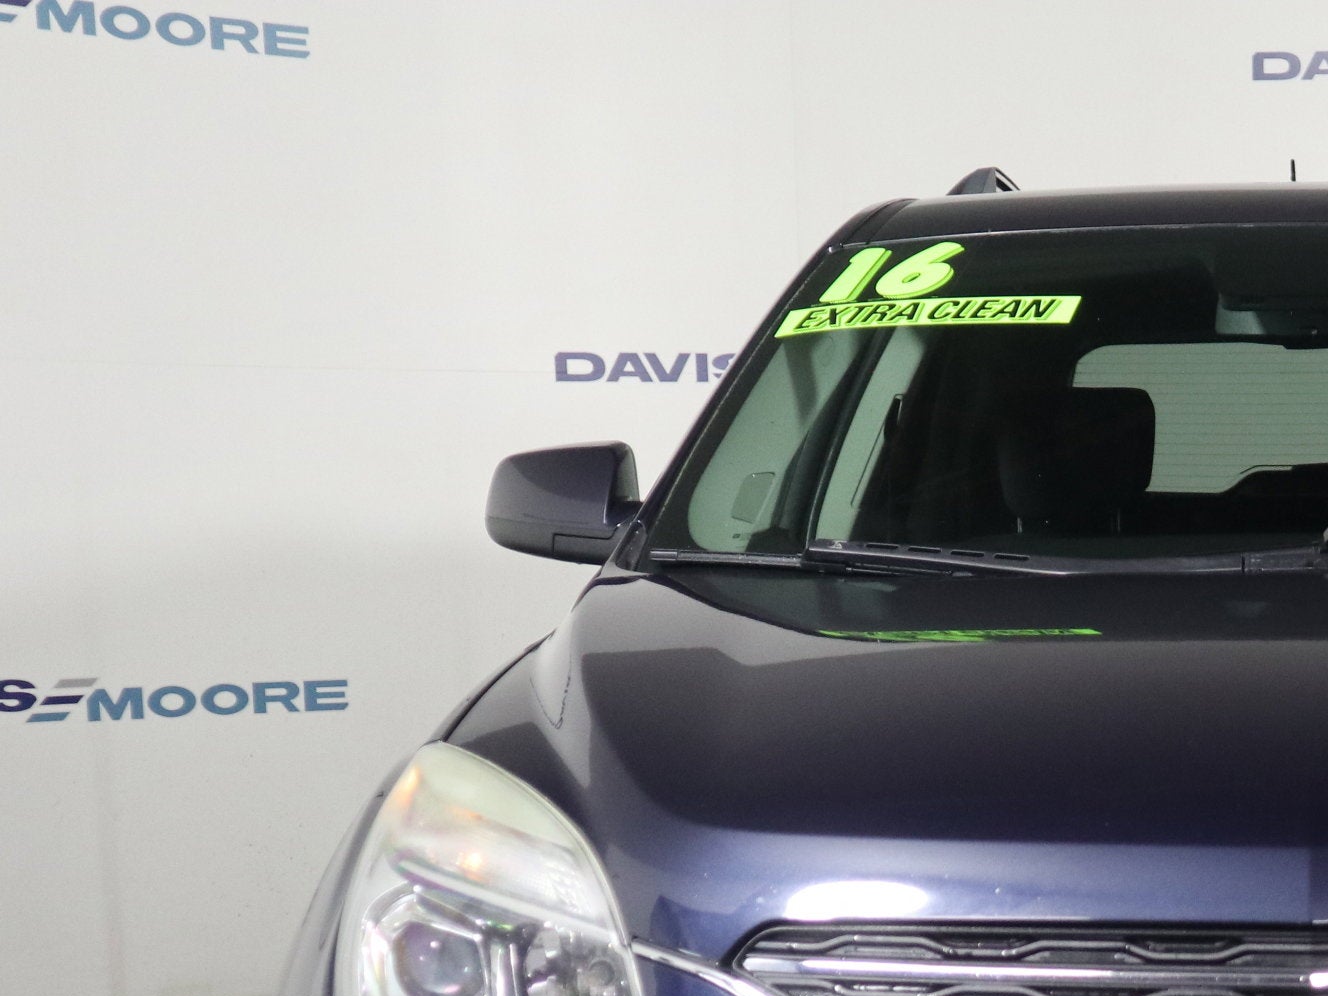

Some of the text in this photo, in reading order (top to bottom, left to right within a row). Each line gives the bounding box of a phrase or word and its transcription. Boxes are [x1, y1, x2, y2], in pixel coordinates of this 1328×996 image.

[35, 0, 310, 59] MOORE
[819, 241, 966, 303] 16
[793, 297, 1063, 331] EXTRA CLEAN
[86, 679, 349, 722] MOORE
